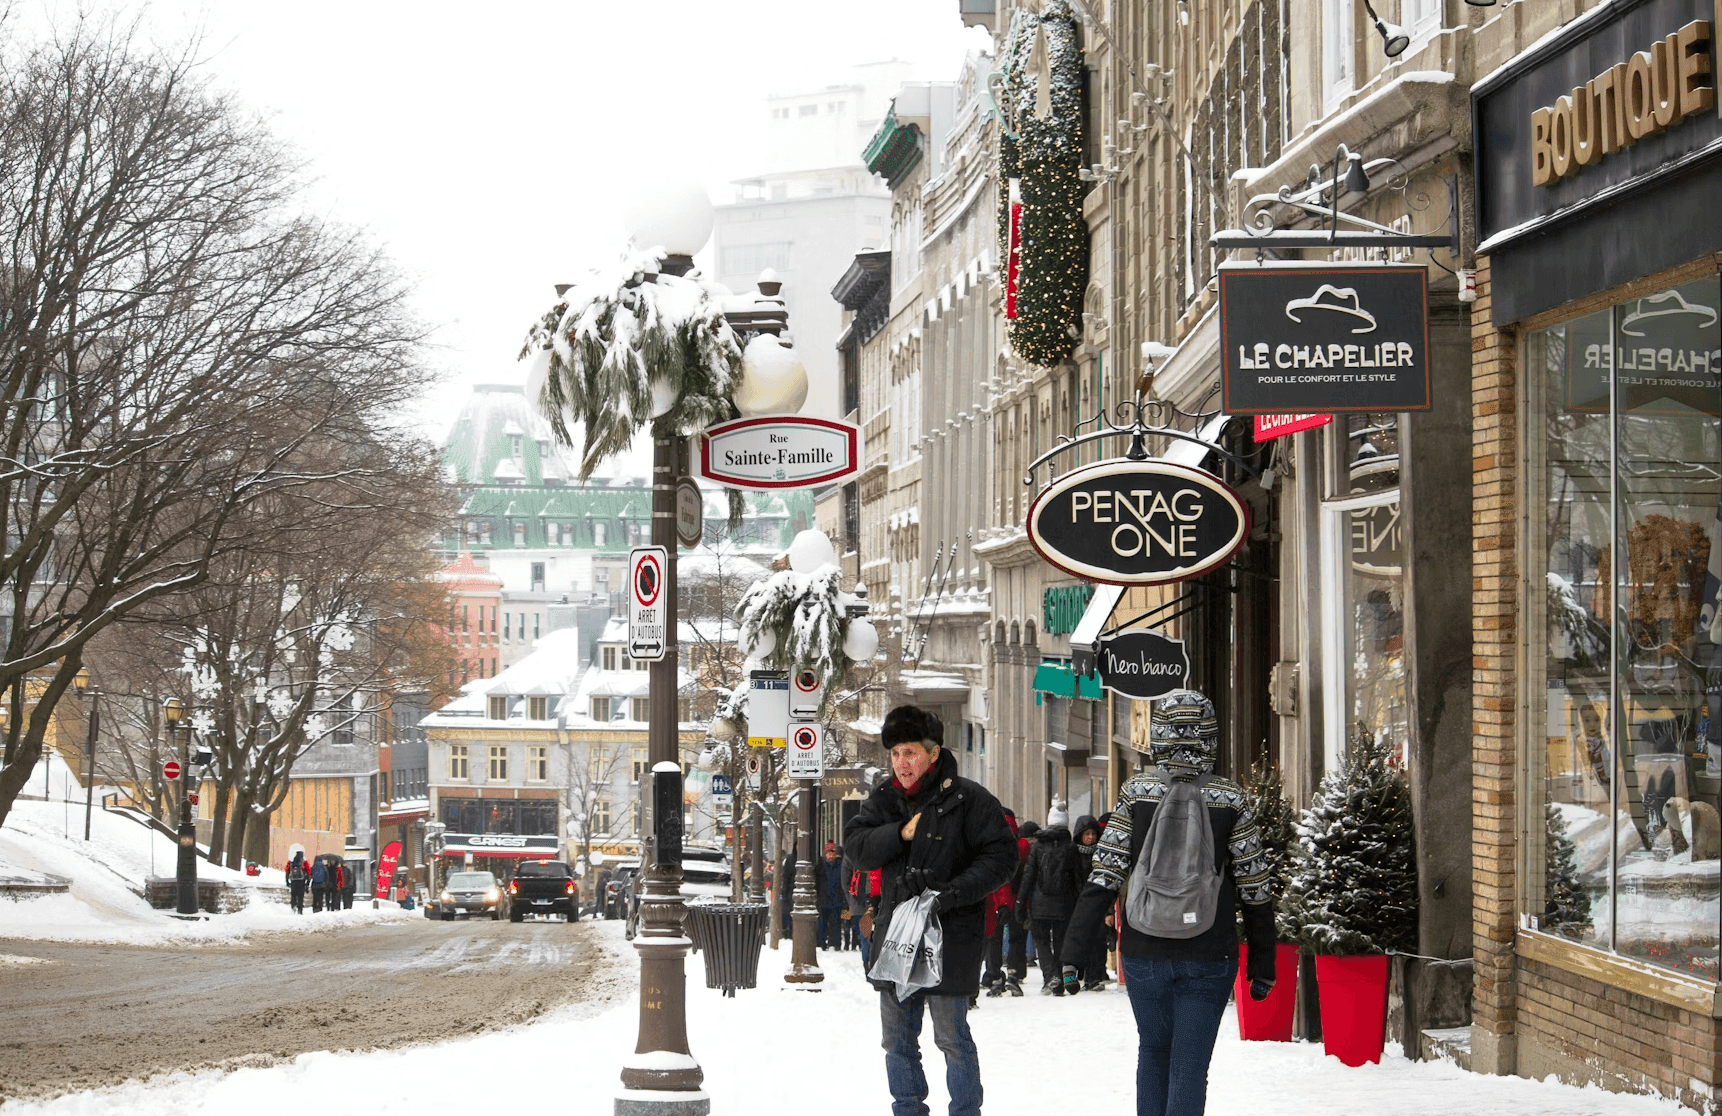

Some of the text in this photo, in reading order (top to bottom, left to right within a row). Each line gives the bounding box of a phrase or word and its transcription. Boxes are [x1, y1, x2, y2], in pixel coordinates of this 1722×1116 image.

[1531, 19, 1714, 188] BOUTIQUE
[1239, 341, 1414, 369] LE CHAPELIER
[1258, 374, 1396, 384] POUR LE CONFORT ET LE STYLE
[769, 434, 789, 444] Rue
[725, 448, 833, 466] Sainte-Famille
[1072, 489, 1204, 523] PENTAG
[1111, 523, 1197, 557] ONE
[631, 625, 662, 639] D'AUTOBUS
[1104, 648, 1182, 675] Nero bianco
[763, 681, 774, 690] 11
[821, 777, 860, 786] RTISANS
